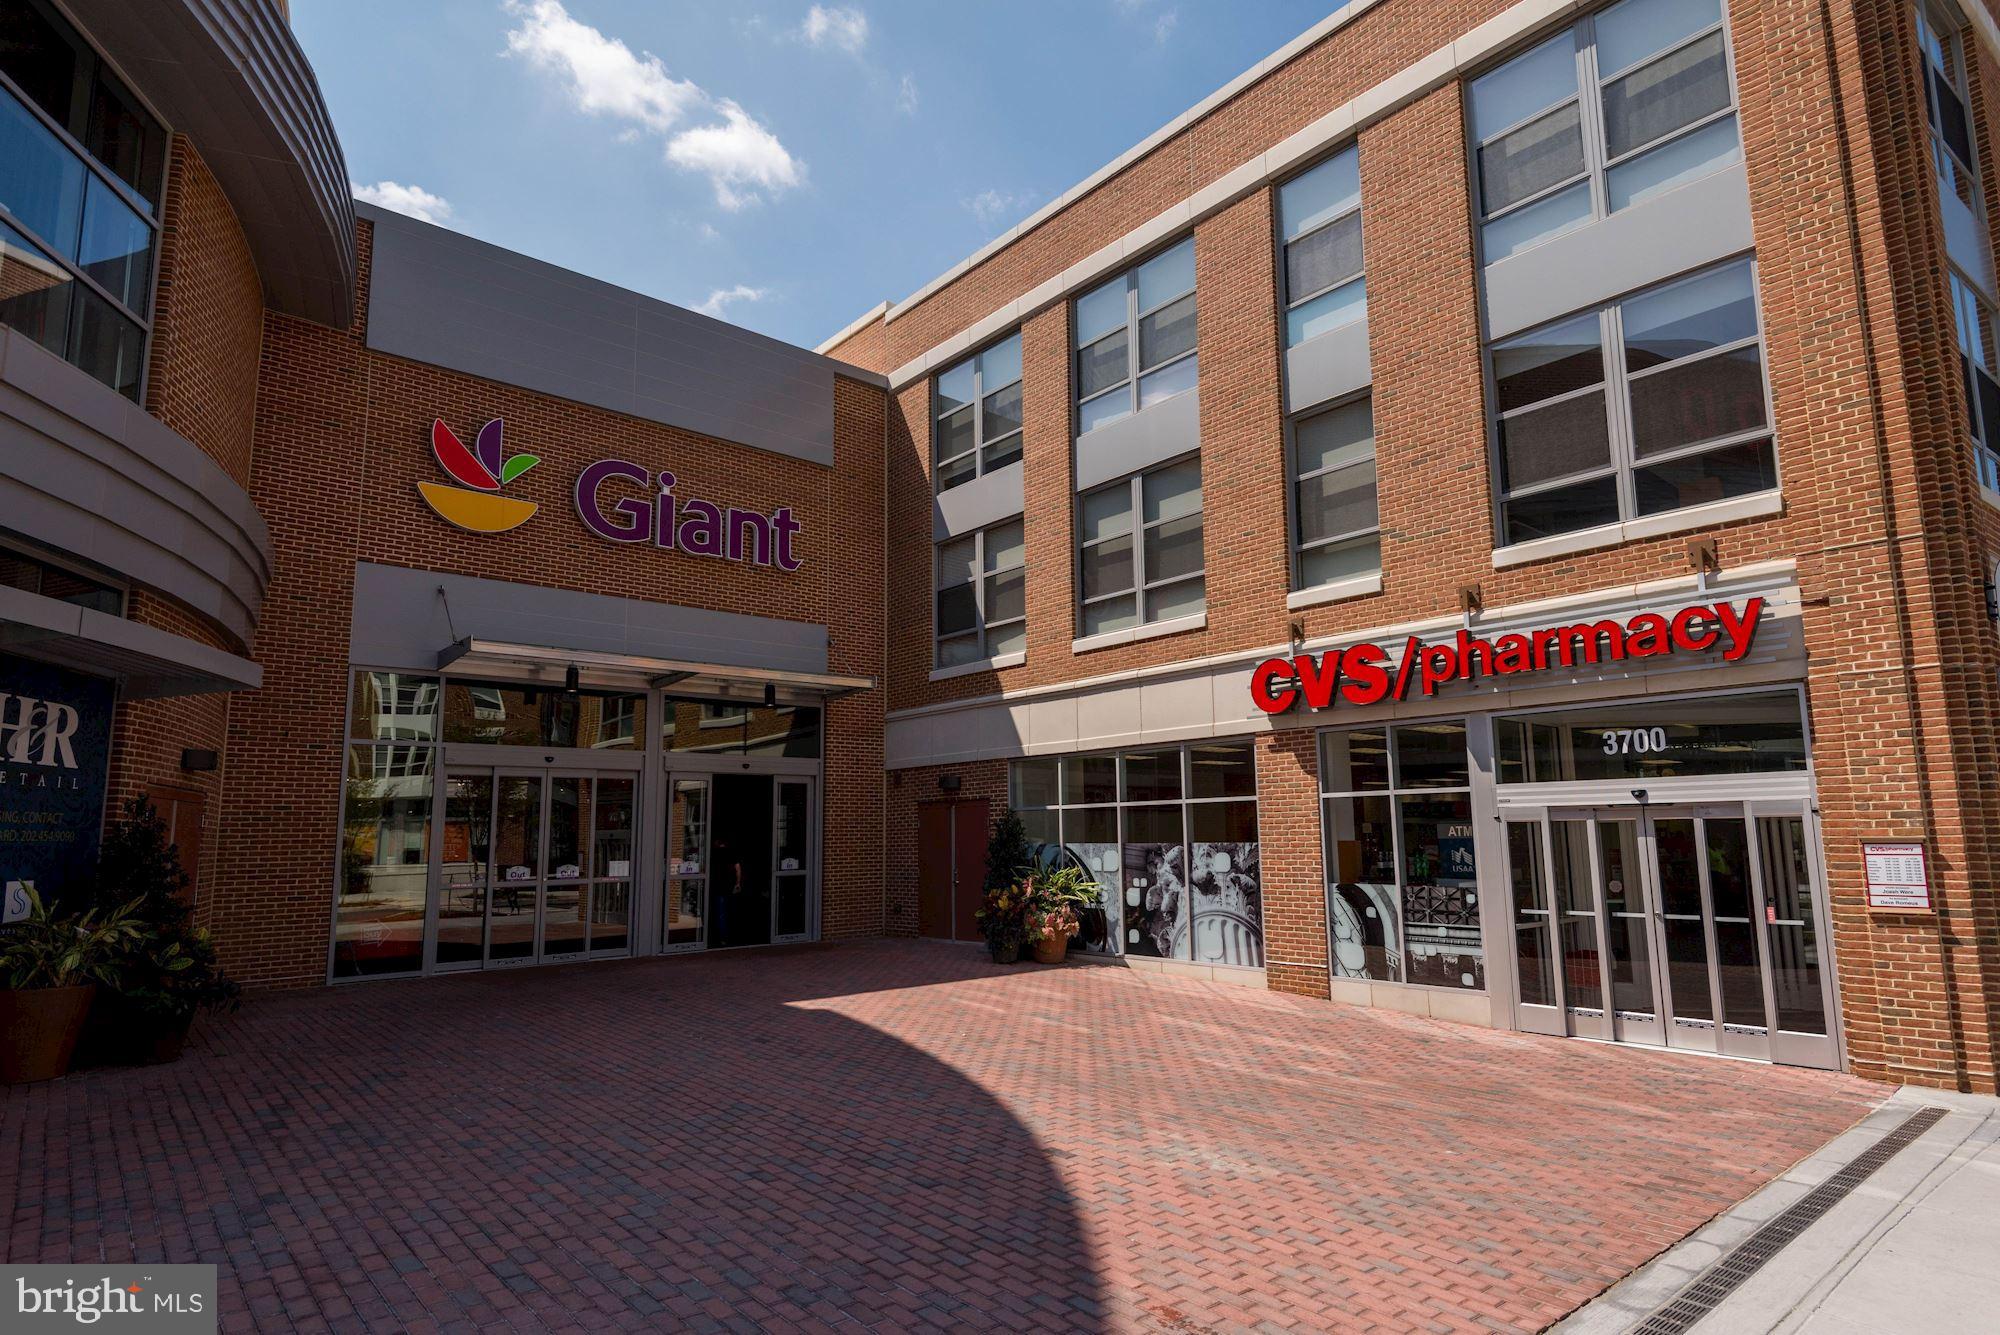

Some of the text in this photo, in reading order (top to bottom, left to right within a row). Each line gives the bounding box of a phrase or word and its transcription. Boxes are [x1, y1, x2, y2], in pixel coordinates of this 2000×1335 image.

[574, 459, 803, 572] Giant
[1250, 597, 1765, 716] CVS/pharmacy
[1602, 727, 1667, 755] 3700
[22, 811, 64, 824] CONTACT
[1448, 825, 1473, 837] ATM
